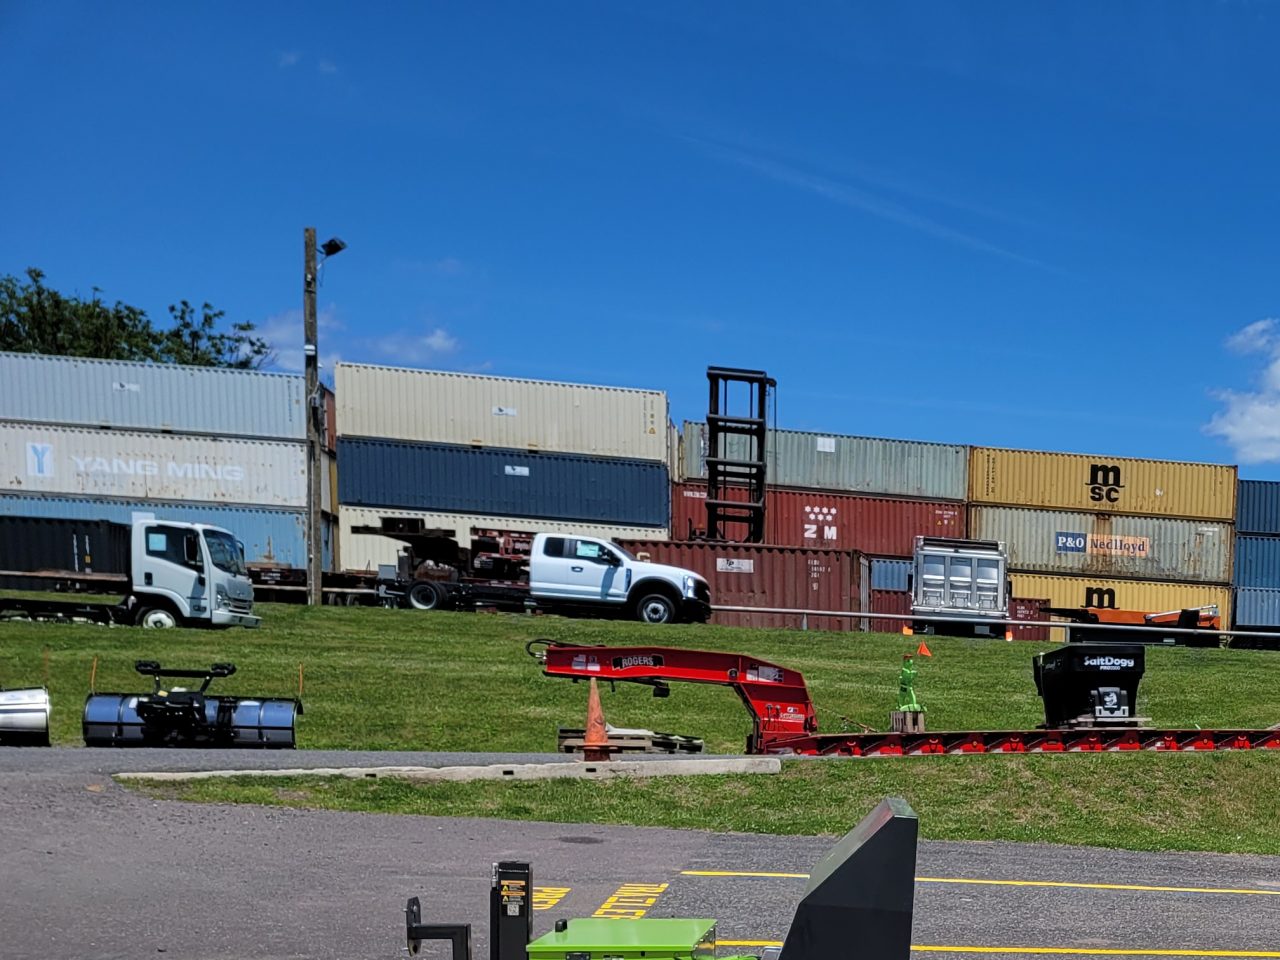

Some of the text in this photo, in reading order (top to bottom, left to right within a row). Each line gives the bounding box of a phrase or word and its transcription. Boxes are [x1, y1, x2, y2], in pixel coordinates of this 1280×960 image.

[71, 455, 245, 481] YANG MING
[1058, 536, 1146, 554] P&O Nedlloyd
[622, 656, 654, 668] ROGERS
[1084, 656, 1135, 667] SaltDogg
